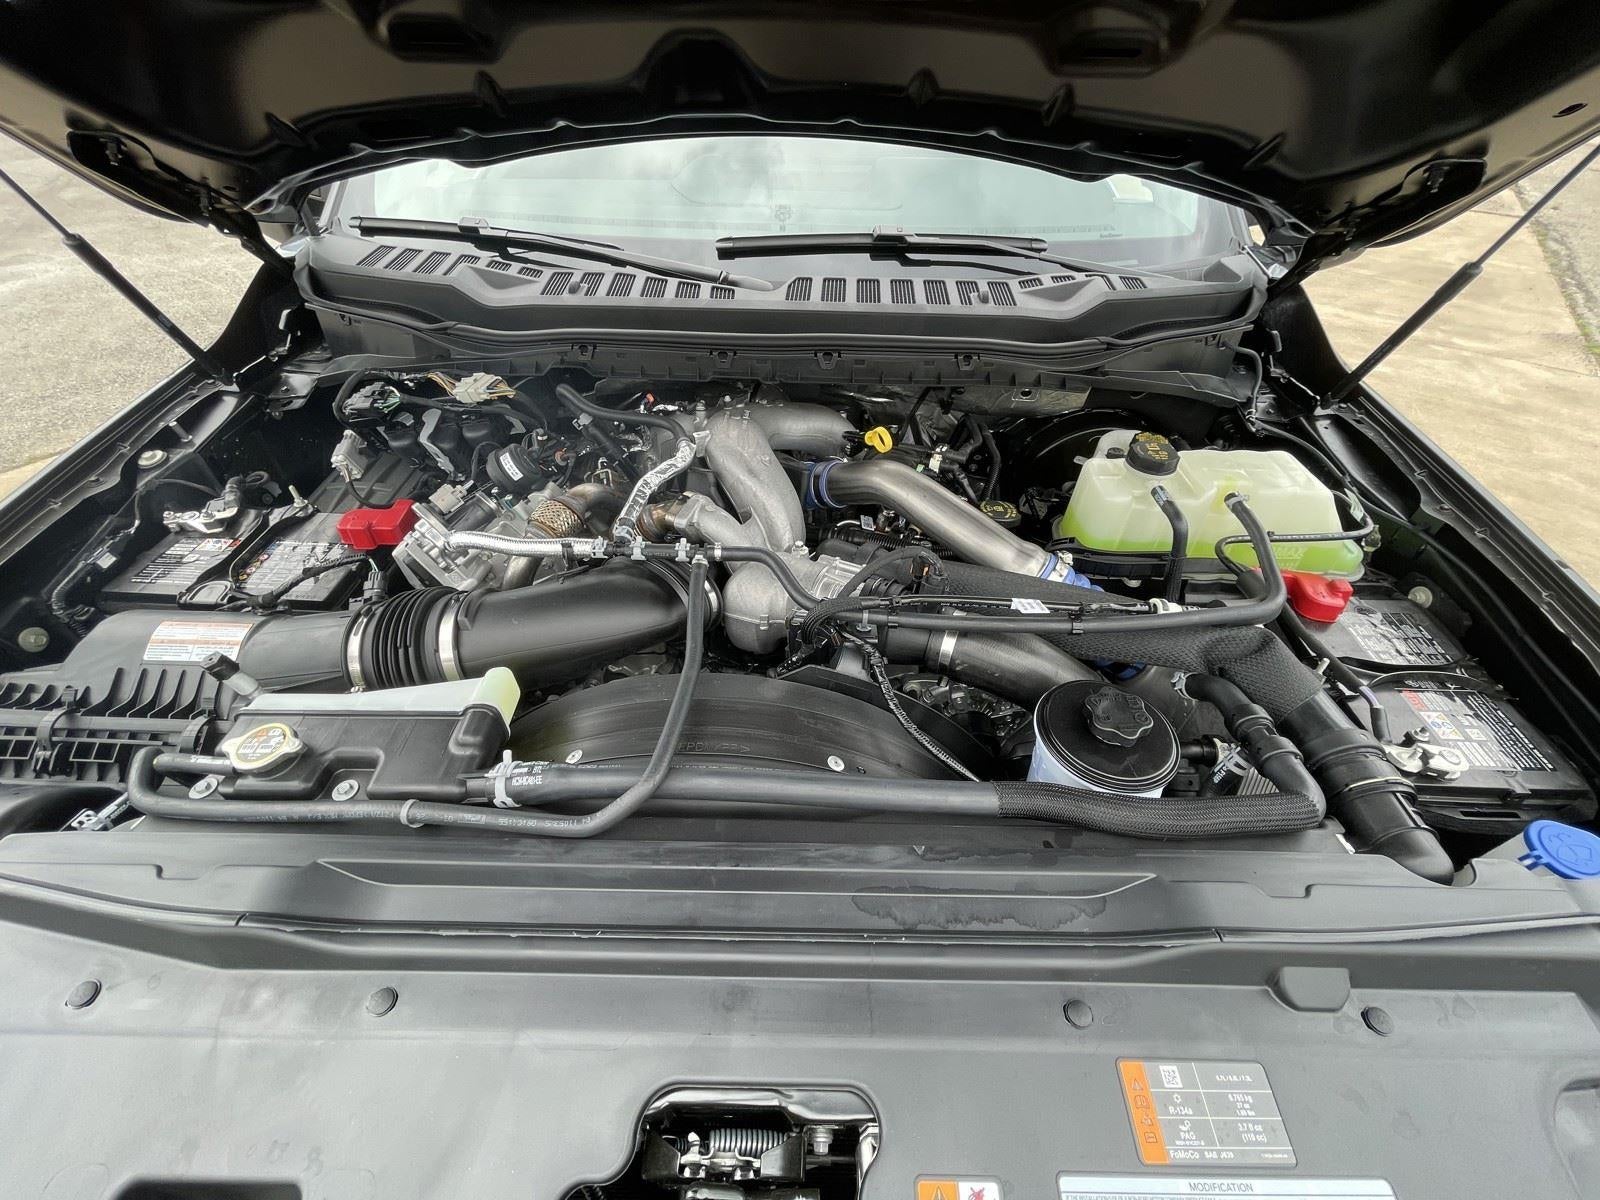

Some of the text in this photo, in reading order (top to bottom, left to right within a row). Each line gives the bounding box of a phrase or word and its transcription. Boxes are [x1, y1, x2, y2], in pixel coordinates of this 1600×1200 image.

[1168, 1106, 1193, 1115] R-134a
[1180, 1132, 1196, 1140] PAG
[1169, 1150, 1200, 1159] FoMoCo
[1188, 1182, 1254, 1192] MODIFICATION
